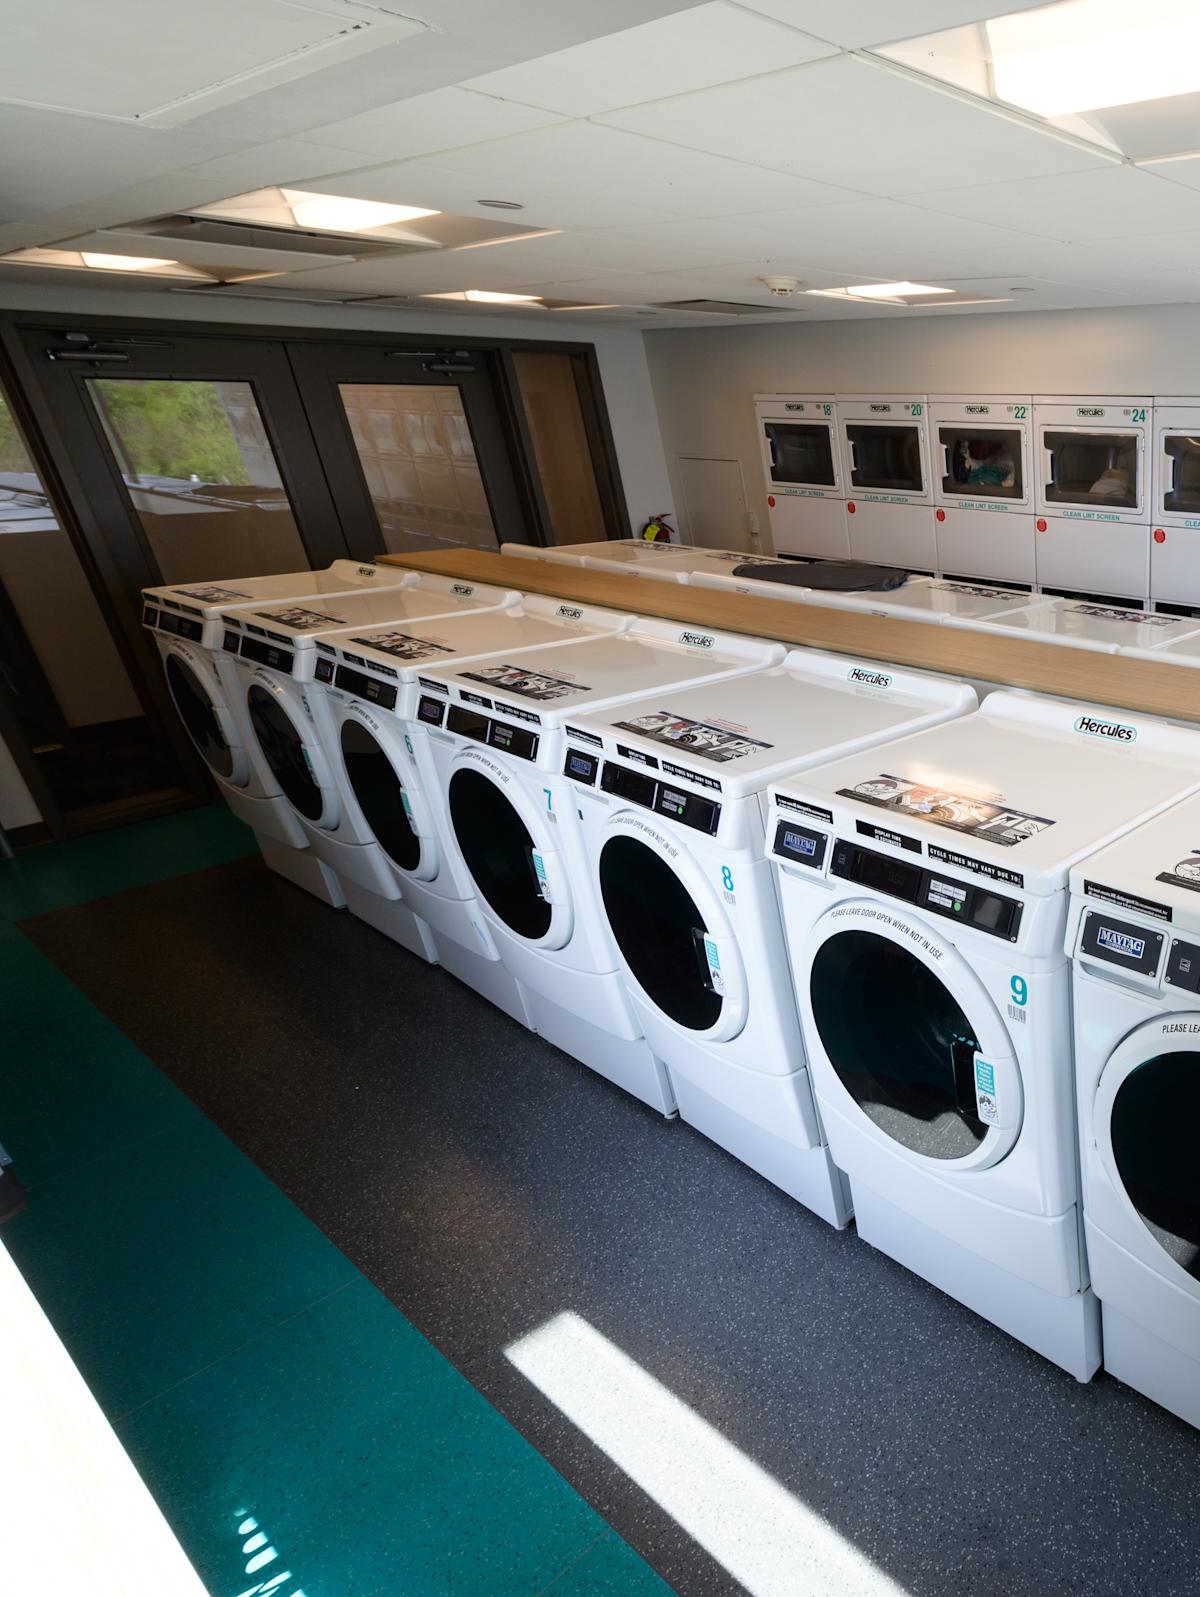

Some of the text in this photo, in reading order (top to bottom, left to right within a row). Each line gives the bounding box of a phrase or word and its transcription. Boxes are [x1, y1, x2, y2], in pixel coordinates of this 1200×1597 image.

[823, 404, 832, 416] 18
[912, 404, 922, 416] 20
[1014, 406, 1026, 418] 22
[1078, 408, 1104, 416] Hercules
[1132, 409, 1146, 422] 24
[682, 632, 712, 647] Hercules
[851, 668, 888, 686] Hercules
[1080, 717, 1132, 740] Hercules
[404, 735, 413, 754] 6
[543, 788, 552, 811] 7
[654, 834, 665, 844] NOT
[668, 848, 678, 858] USE
[786, 834, 814, 850] MAYTAG
[930, 848, 946, 858] CYCLE
[948, 854, 966, 864] TIMES
[967, 860, 979, 869] MAY
[980, 864, 995, 874] VARY
[997, 870, 1008, 879] DUE
[721, 866, 734, 892] 8
[830, 908, 943, 960] PLEASE LEAVE DOOR OPEN WHEN NOT IN USE
[1100, 930, 1142, 951] MAYTAG
[1010, 975, 1028, 1006] 9
[1162, 1024, 1188, 1034] PLEASE
